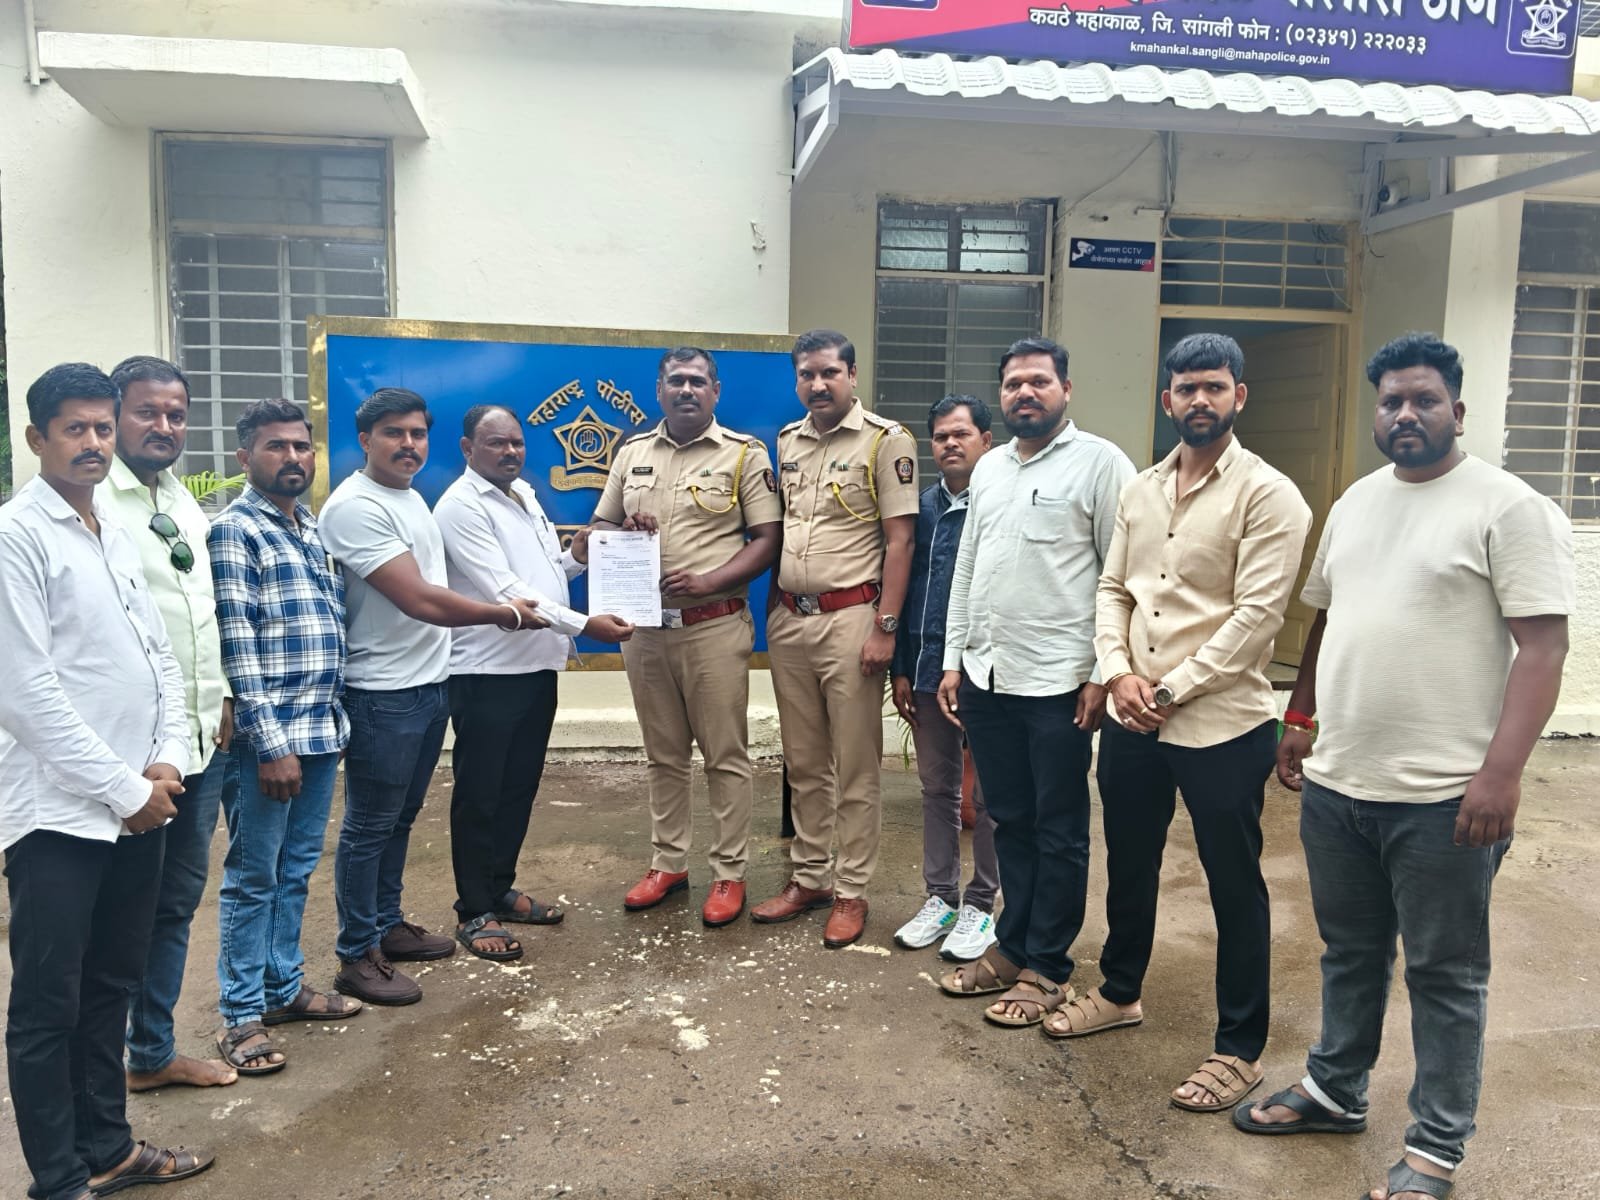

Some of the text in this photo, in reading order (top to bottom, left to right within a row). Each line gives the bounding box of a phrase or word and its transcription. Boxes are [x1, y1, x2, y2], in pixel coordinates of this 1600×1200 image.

[1029, 4, 1071, 27] कवठे
[1075, 7, 1146, 35] महांकाळ,
[1151, 11, 1176, 34] जि.
[1182, 14, 1233, 38] सांगली
[1237, 18, 1271, 40] फोन
[1285, 23, 1357, 50] (०२३४१)
[1363, 32, 1427, 55] २२२०३३
[1130, 41, 1330, 65] kmahankal.sangli@mahapolice.gov.in
[1121, 246, 1142, 254] CCTV
[527, 379, 648, 427] महाराष्ट्र पोलीस
